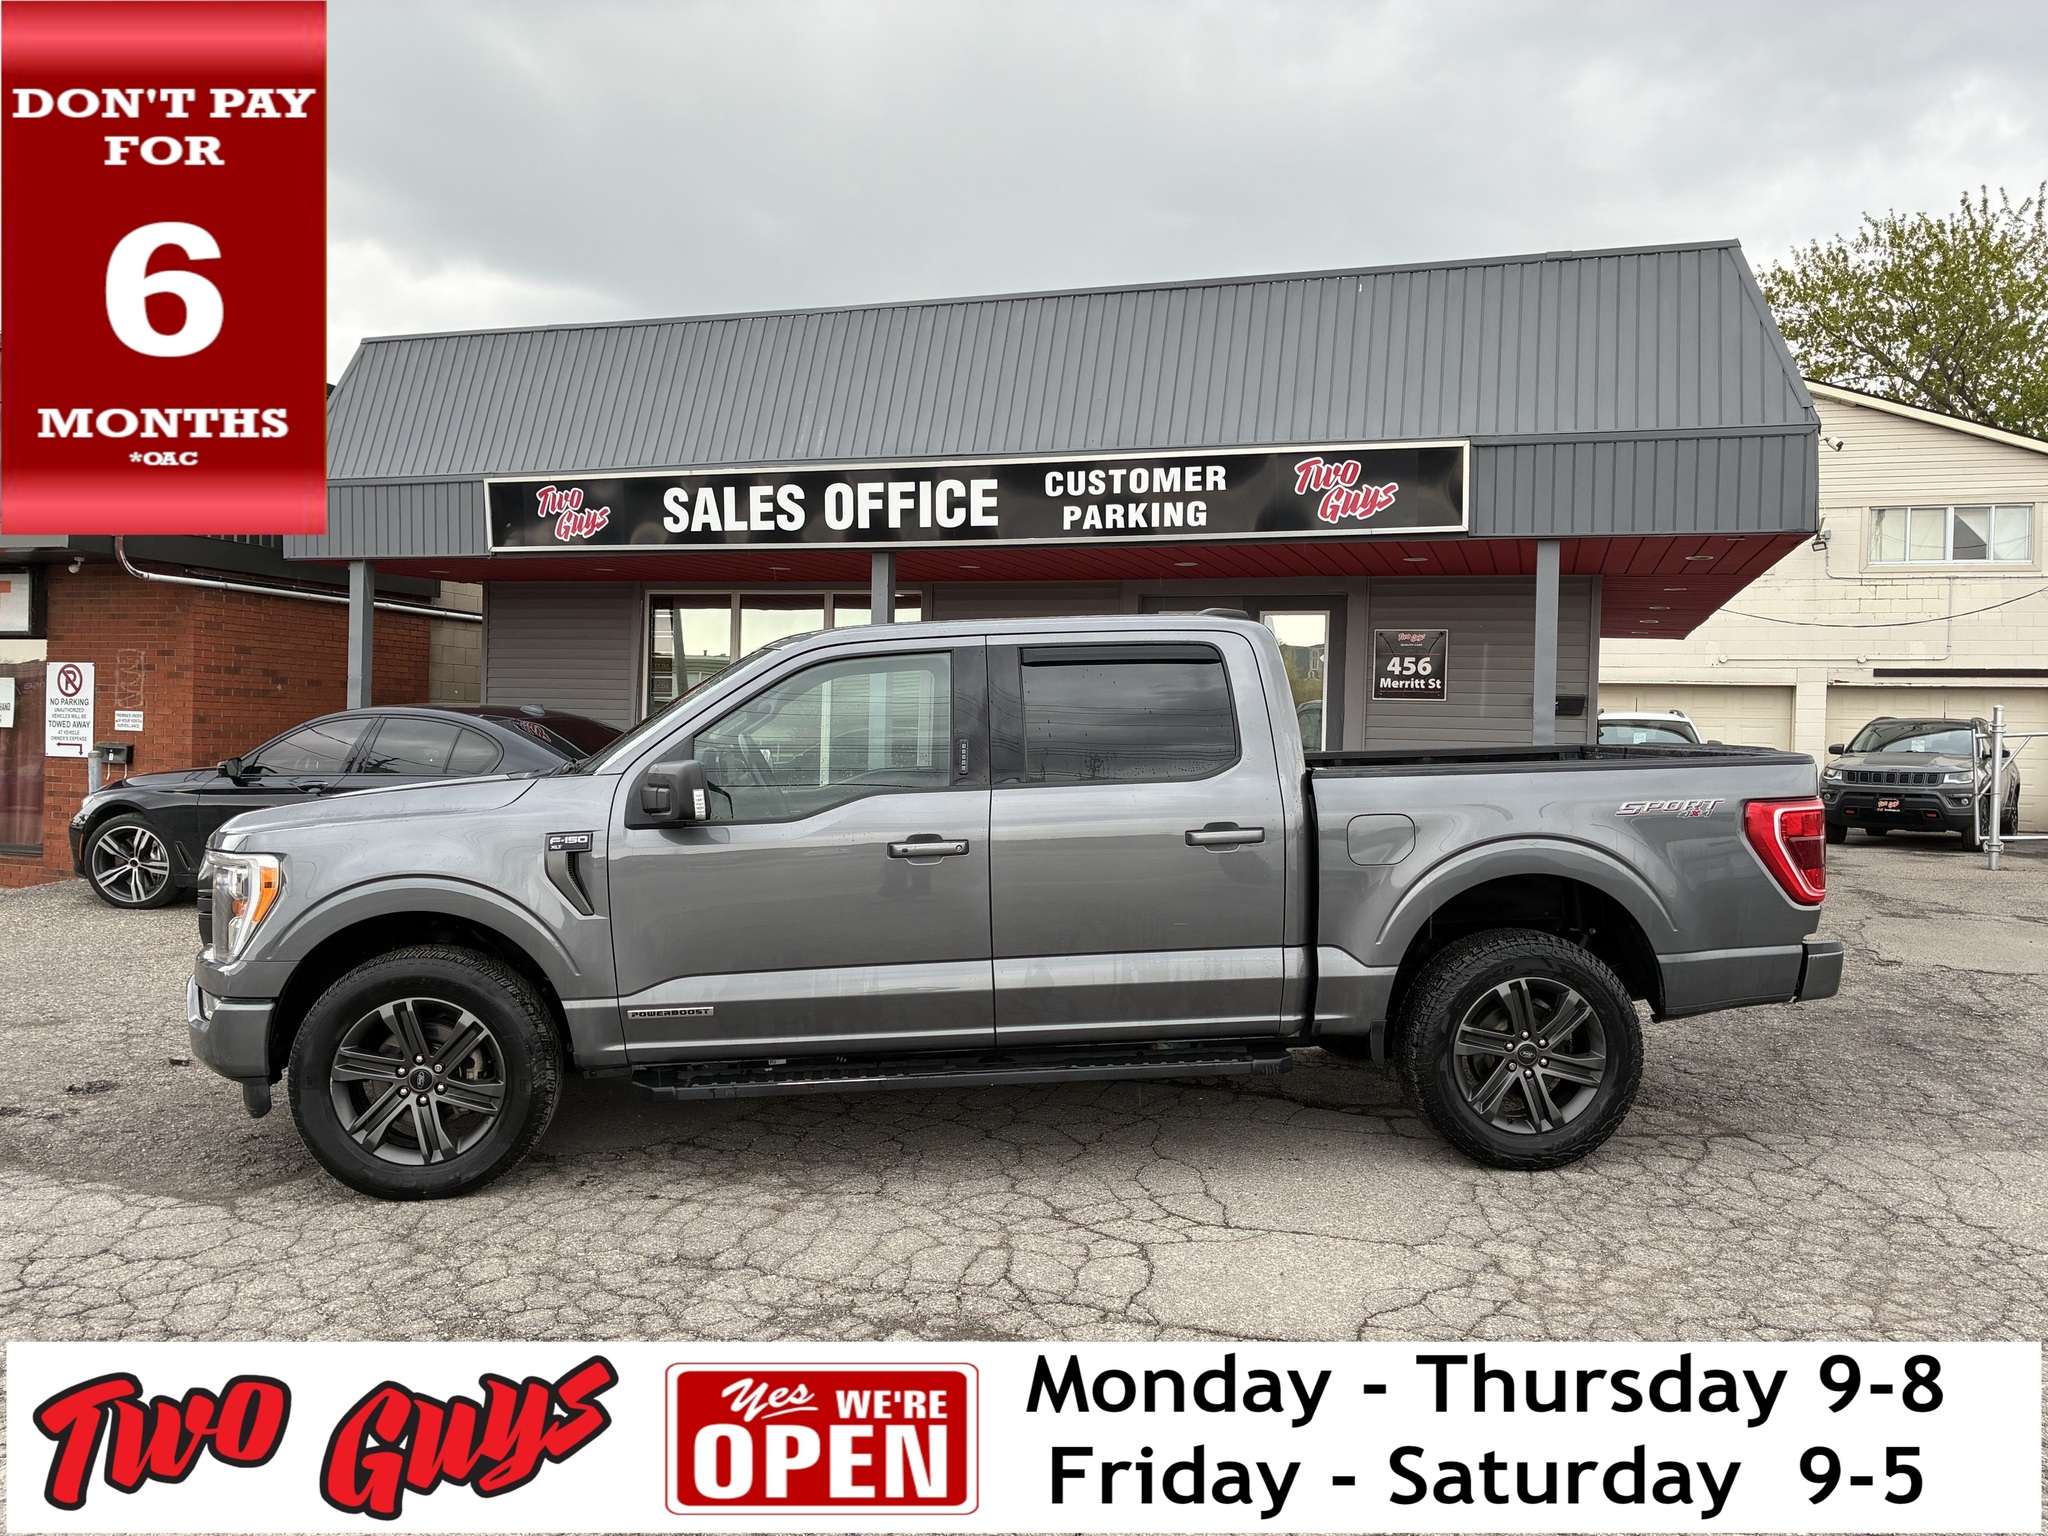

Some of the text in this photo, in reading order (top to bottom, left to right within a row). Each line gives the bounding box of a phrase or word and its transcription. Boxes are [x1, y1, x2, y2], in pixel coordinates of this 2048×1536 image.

[1045, 465, 1227, 497] CUSTOMER
[1294, 457, 1361, 495] Two
[536, 485, 583, 517] Two
[663, 479, 999, 533] SALES OFFICE
[1317, 482, 1399, 524] Guys
[555, 508, 611, 542] Guys
[1063, 501, 1207, 530] PARKING
[1387, 657, 1432, 676] 456
[1380, 678, 1442, 689] Merritt St
[60, 698, 90, 706] PARKING
[48, 720, 91, 728] TOWED AWAY
[1615, 798, 1726, 816] SPORT
[550, 836, 588, 844] F-150
[631, 1008, 710, 1017] POWERBOOST
